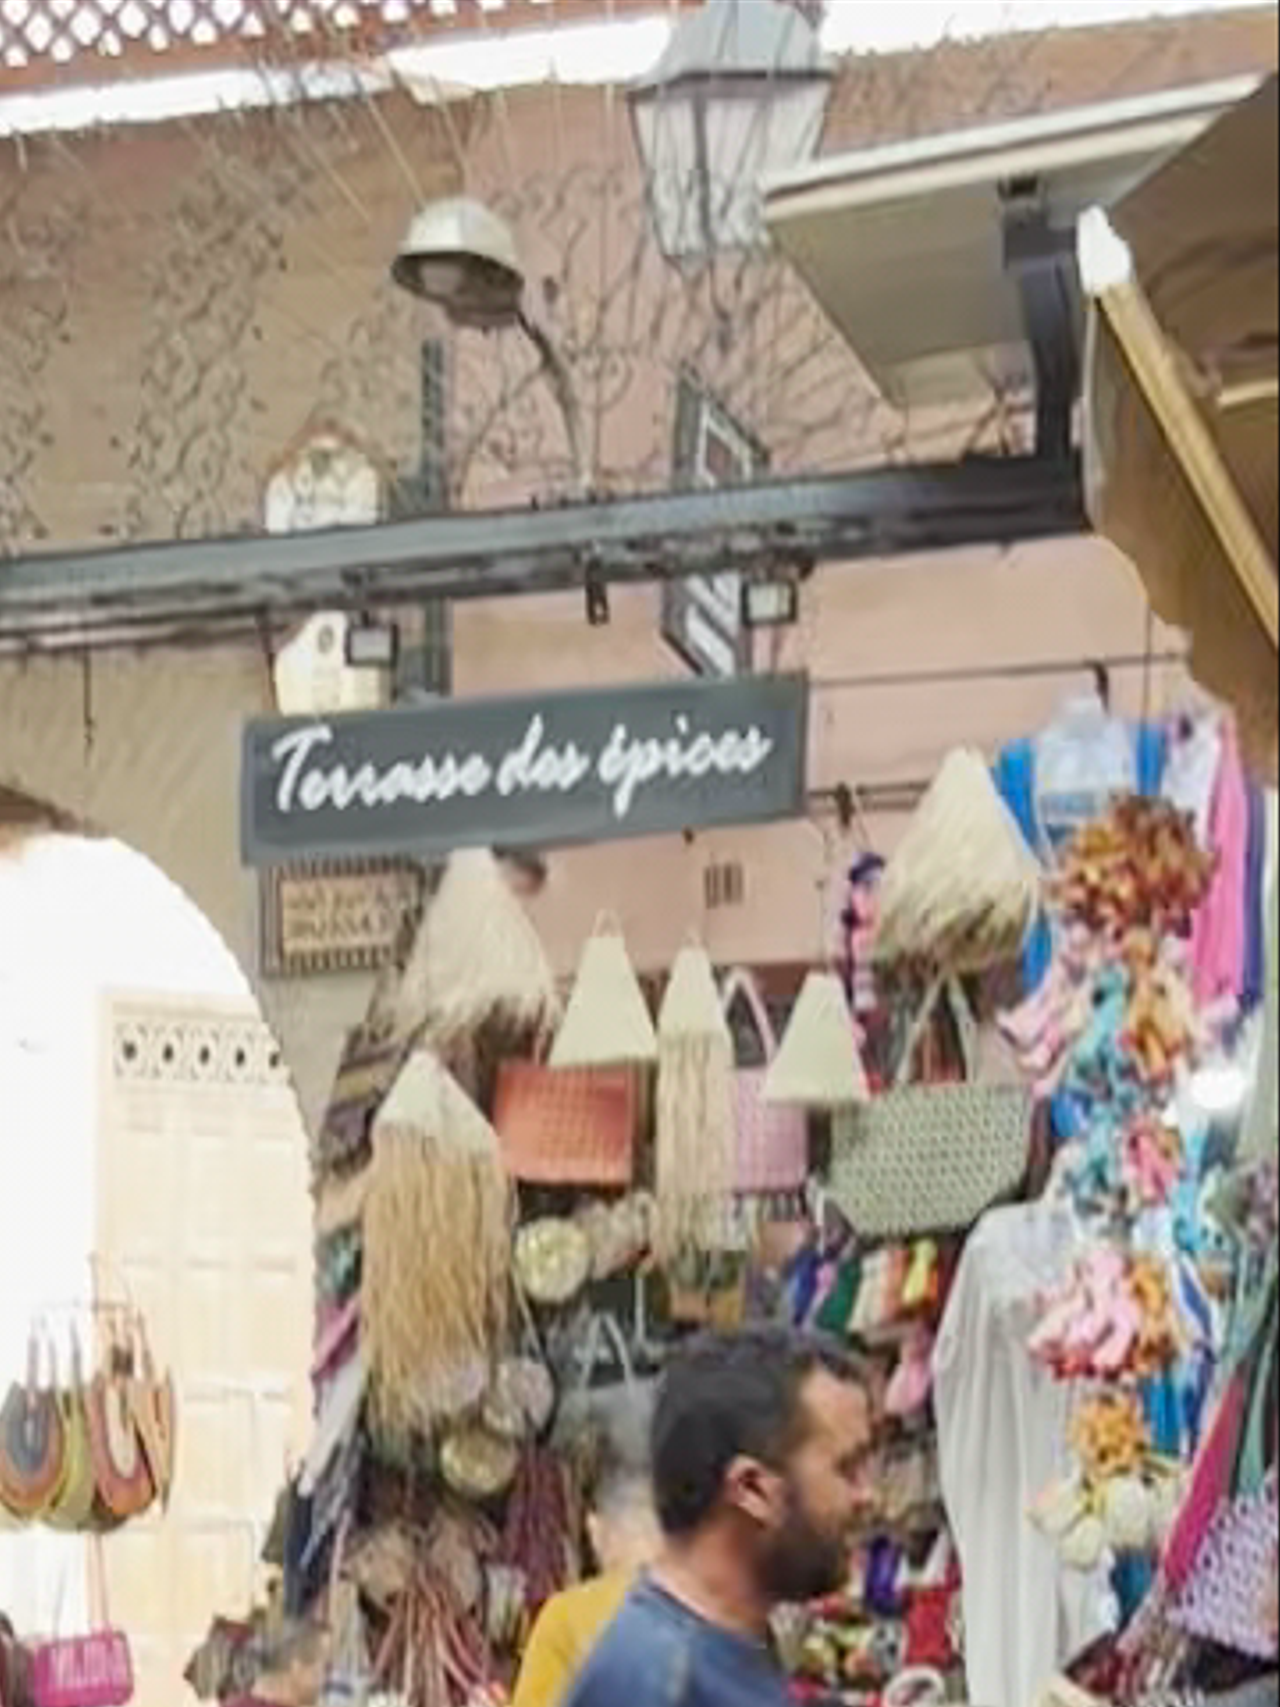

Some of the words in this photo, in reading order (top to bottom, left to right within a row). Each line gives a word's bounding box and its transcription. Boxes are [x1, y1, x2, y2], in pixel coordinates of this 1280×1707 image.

[271, 725, 491, 812] Terrasse
[496, 715, 589, 795] des
[598, 716, 771, 818] épices
